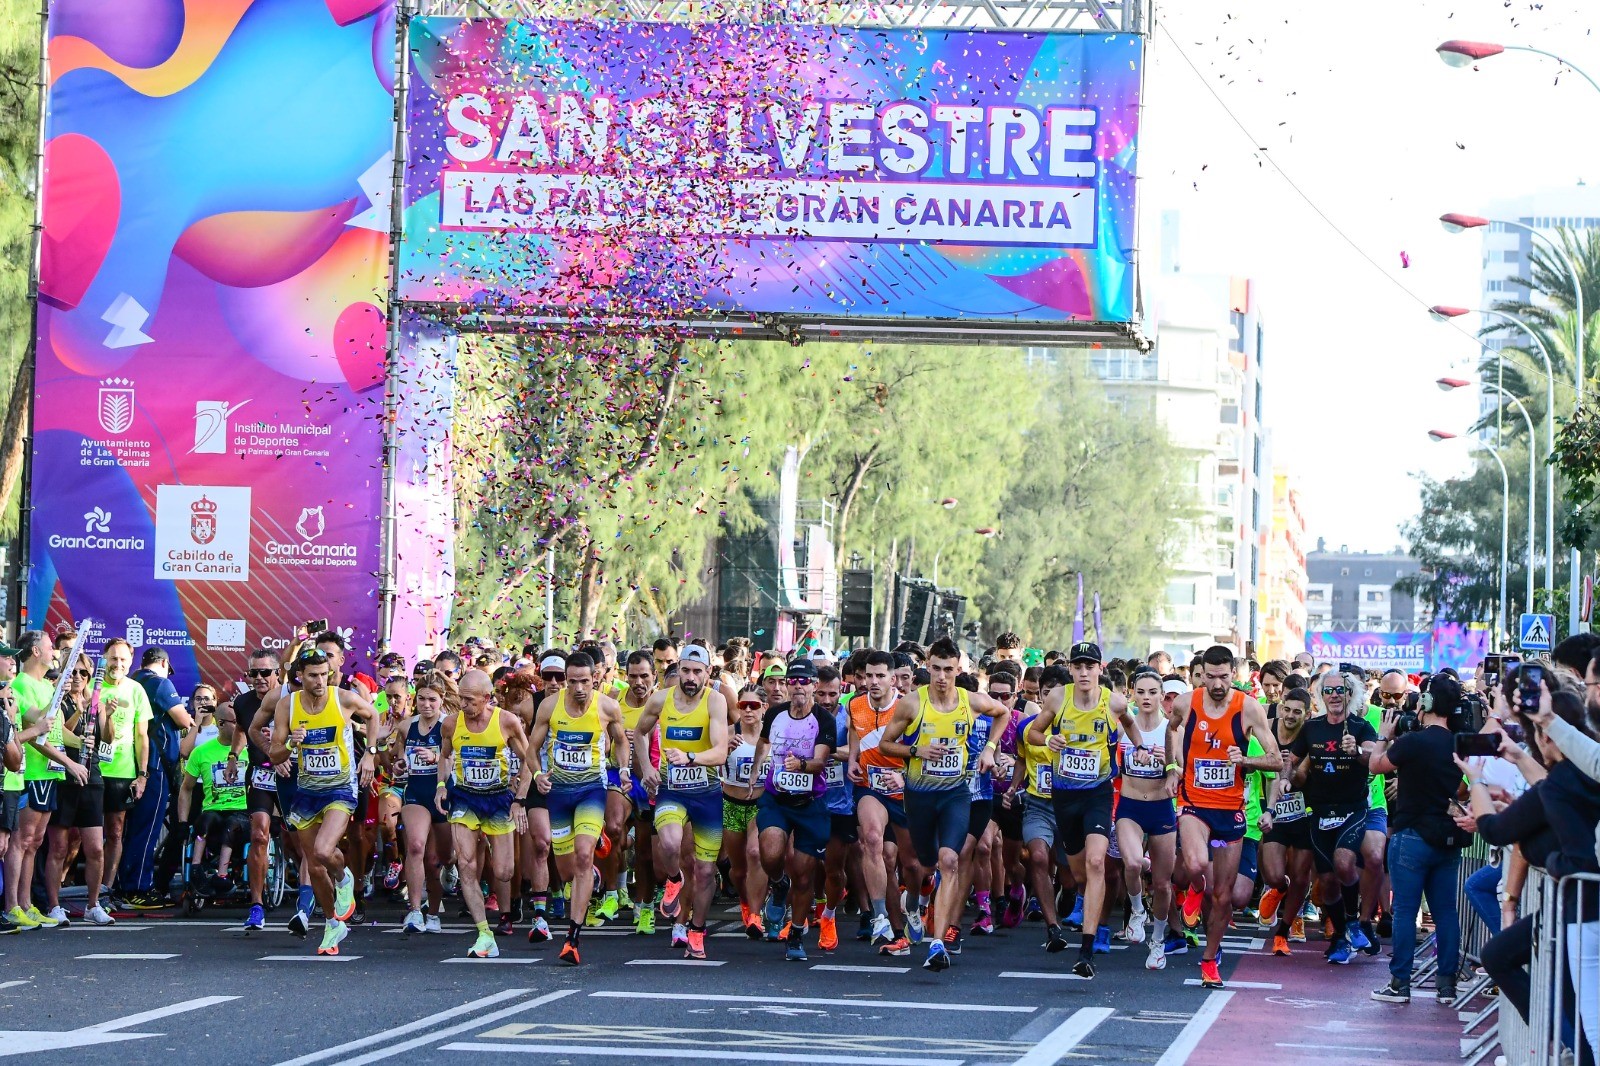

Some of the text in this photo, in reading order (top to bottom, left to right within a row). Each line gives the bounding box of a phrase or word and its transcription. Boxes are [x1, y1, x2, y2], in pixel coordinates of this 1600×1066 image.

[464, 185, 537, 215] LAS
[775, 193, 880, 224] GRAN
[893, 196, 1072, 230] CANARIA
[234, 422, 332, 437] Instituto Municipal
[80, 438, 151, 448] Ayuntamiento
[234, 436, 299, 448] de Deportes
[80, 448, 151, 458] de Las Palmas
[248, 448, 273, 456] Palmas
[80, 457, 150, 467] de Gran Canaria
[168, 550, 234, 561] Cabildo de
[264, 556, 358, 567] Isla Europea del Deporte
[162, 561, 242, 574] Gran Canaria
[146, 628, 187, 637] Gobierno
[146, 637, 196, 646] de Canarias
[1312, 645, 1424, 658] SAN SILVESTRE
[307, 729, 327, 737] HPS
[308, 755, 336, 768] 3203
[560, 751, 586, 764] 1184
[1066, 755, 1096, 772] 3933
[471, 767, 495, 780] 1187
[675, 767, 703, 781] 2202
[780, 773, 809, 787] 5369
[1203, 768, 1230, 781] 5811
[1275, 800, 1302, 815] 6203
